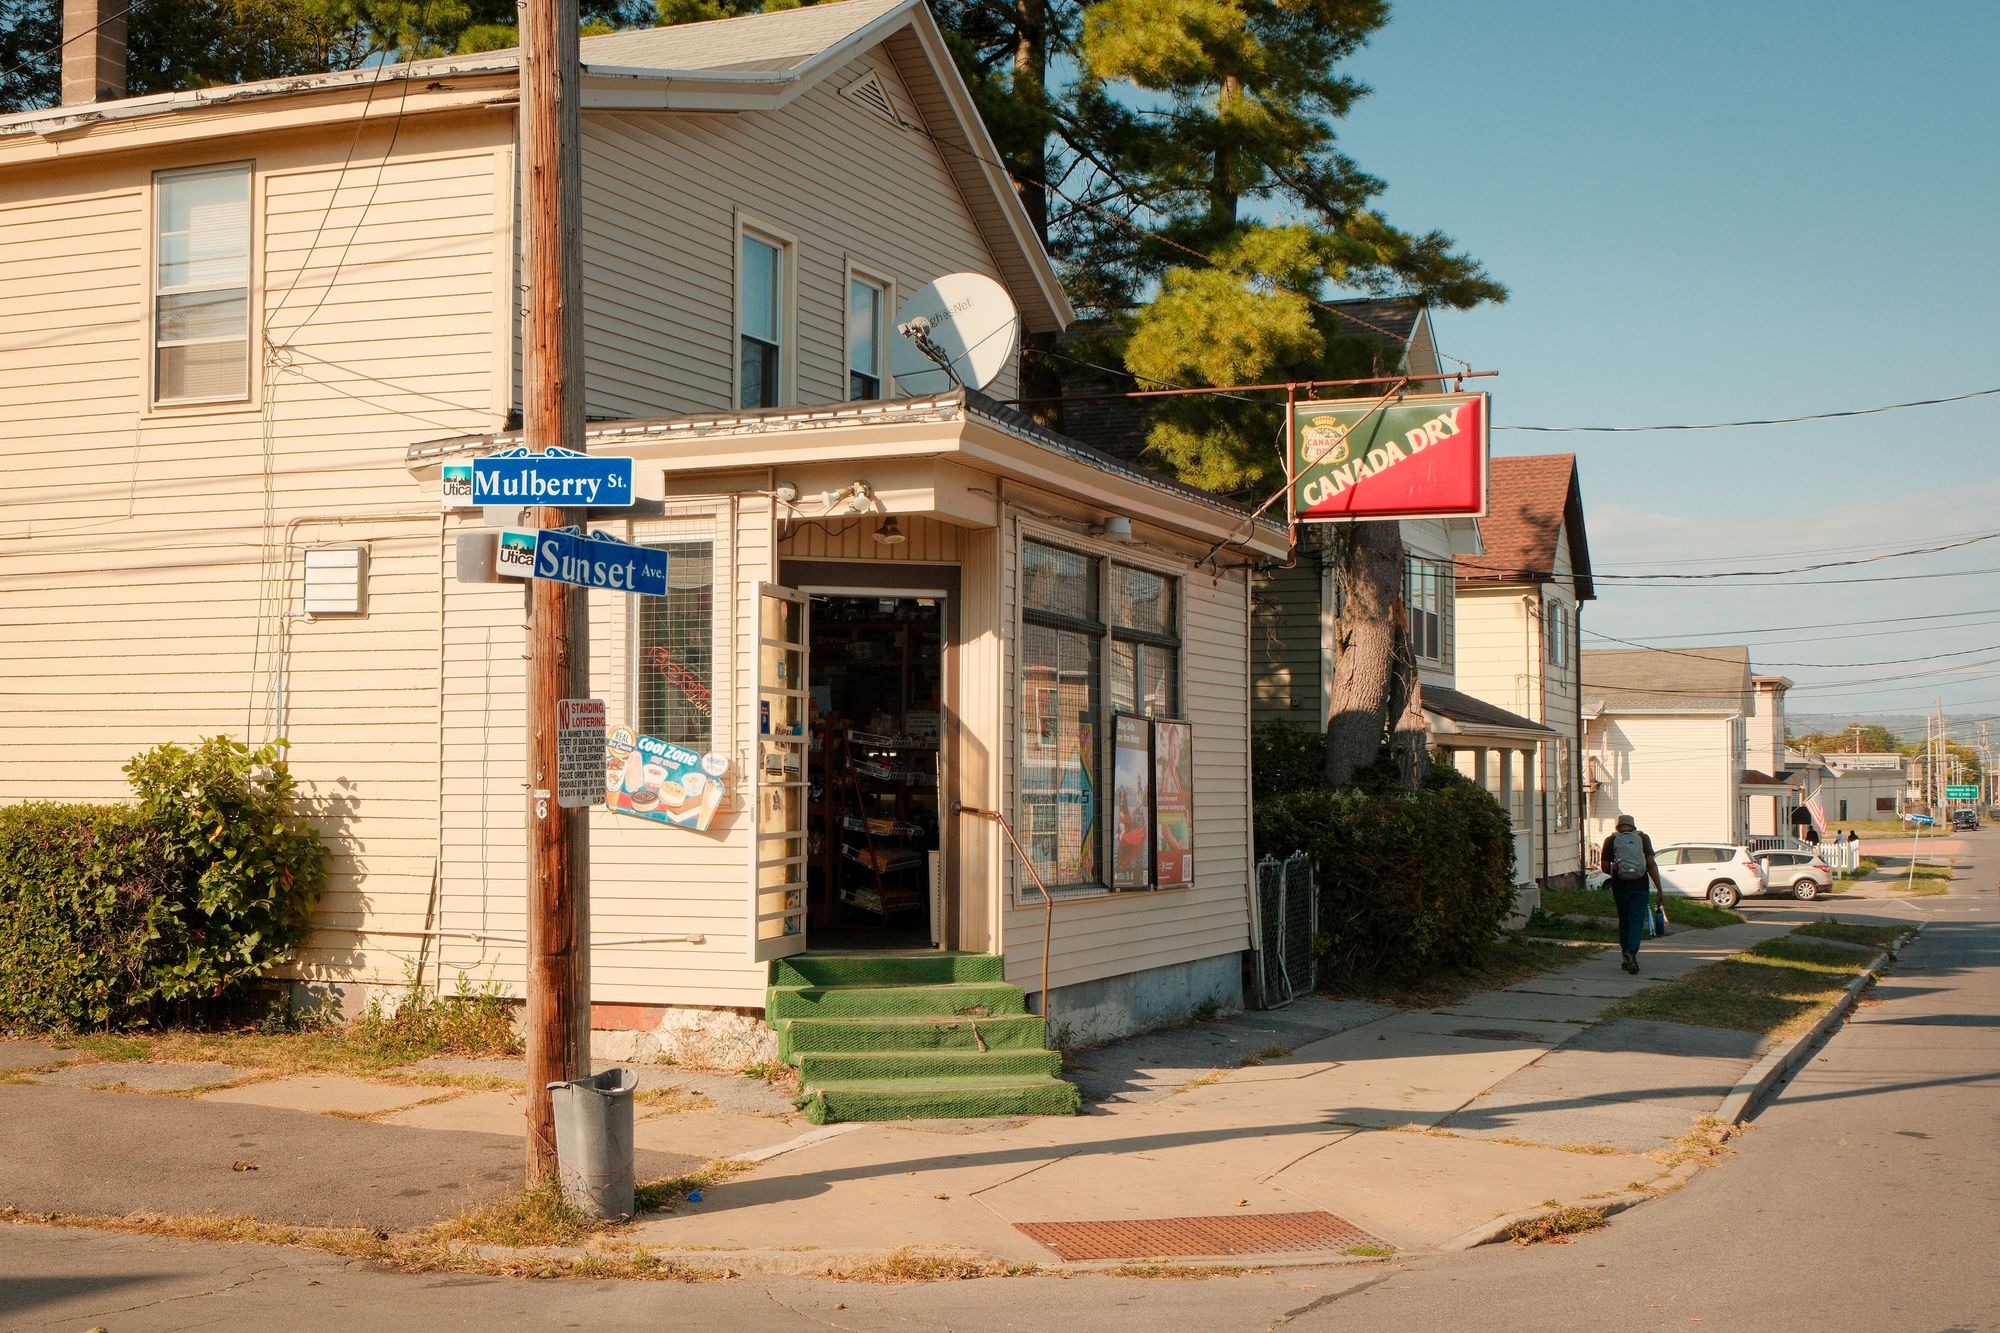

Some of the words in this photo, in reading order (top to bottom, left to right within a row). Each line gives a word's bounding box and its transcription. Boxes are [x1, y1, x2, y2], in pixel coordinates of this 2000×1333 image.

[930, 298, 971, 328] ghesNet
[1303, 440, 1408, 506] CANADA
[1405, 406, 1462, 455] DRY
[443, 482, 472, 496] Utica
[474, 470, 602, 502] Mulberry
[608, 474, 627, 488] St.
[500, 550, 534, 566] Utica
[539, 540, 636, 590] Sunset
[642, 564, 665, 579] Ave.
[560, 701, 570, 730] NO
[572, 717, 606, 728] LOITERING
[615, 732, 629, 743] REAL
[638, 737, 665, 757] Cool
[664, 746, 698, 766] Zone
[536, 800, 547, 818] 6
